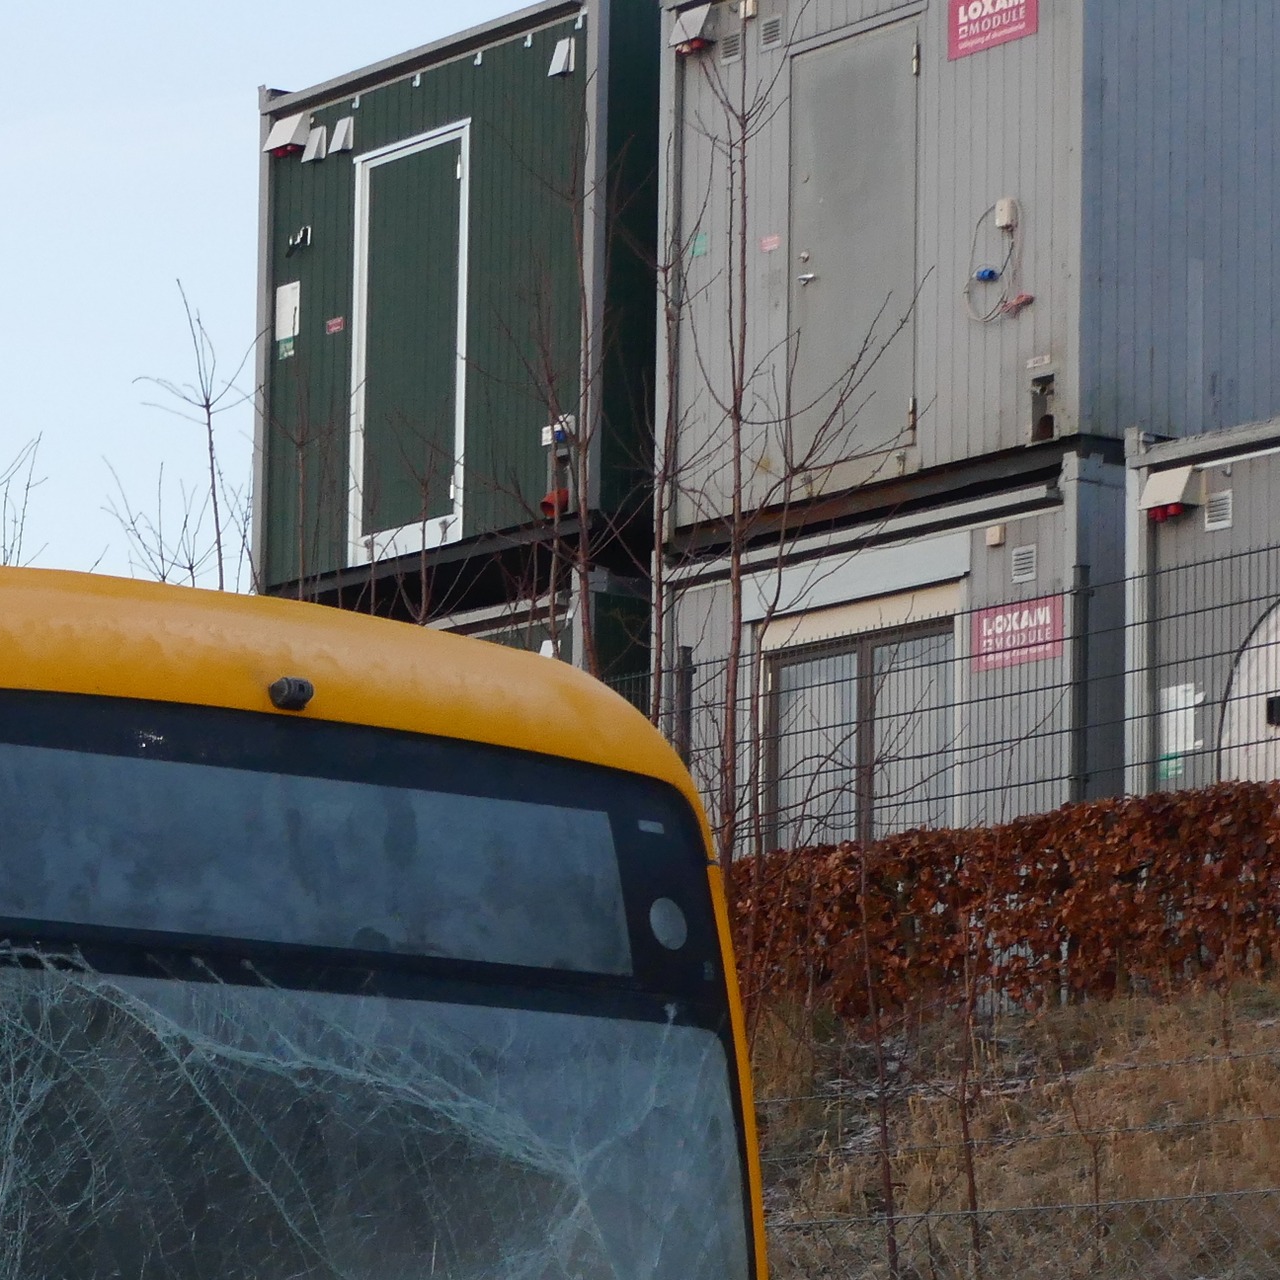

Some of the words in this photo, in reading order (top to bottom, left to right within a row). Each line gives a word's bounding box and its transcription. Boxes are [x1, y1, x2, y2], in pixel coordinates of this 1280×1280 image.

[968, 5, 1026, 37] MODULE
[983, 606, 1051, 637] LOXAM
[994, 627, 1052, 650] MODULE
